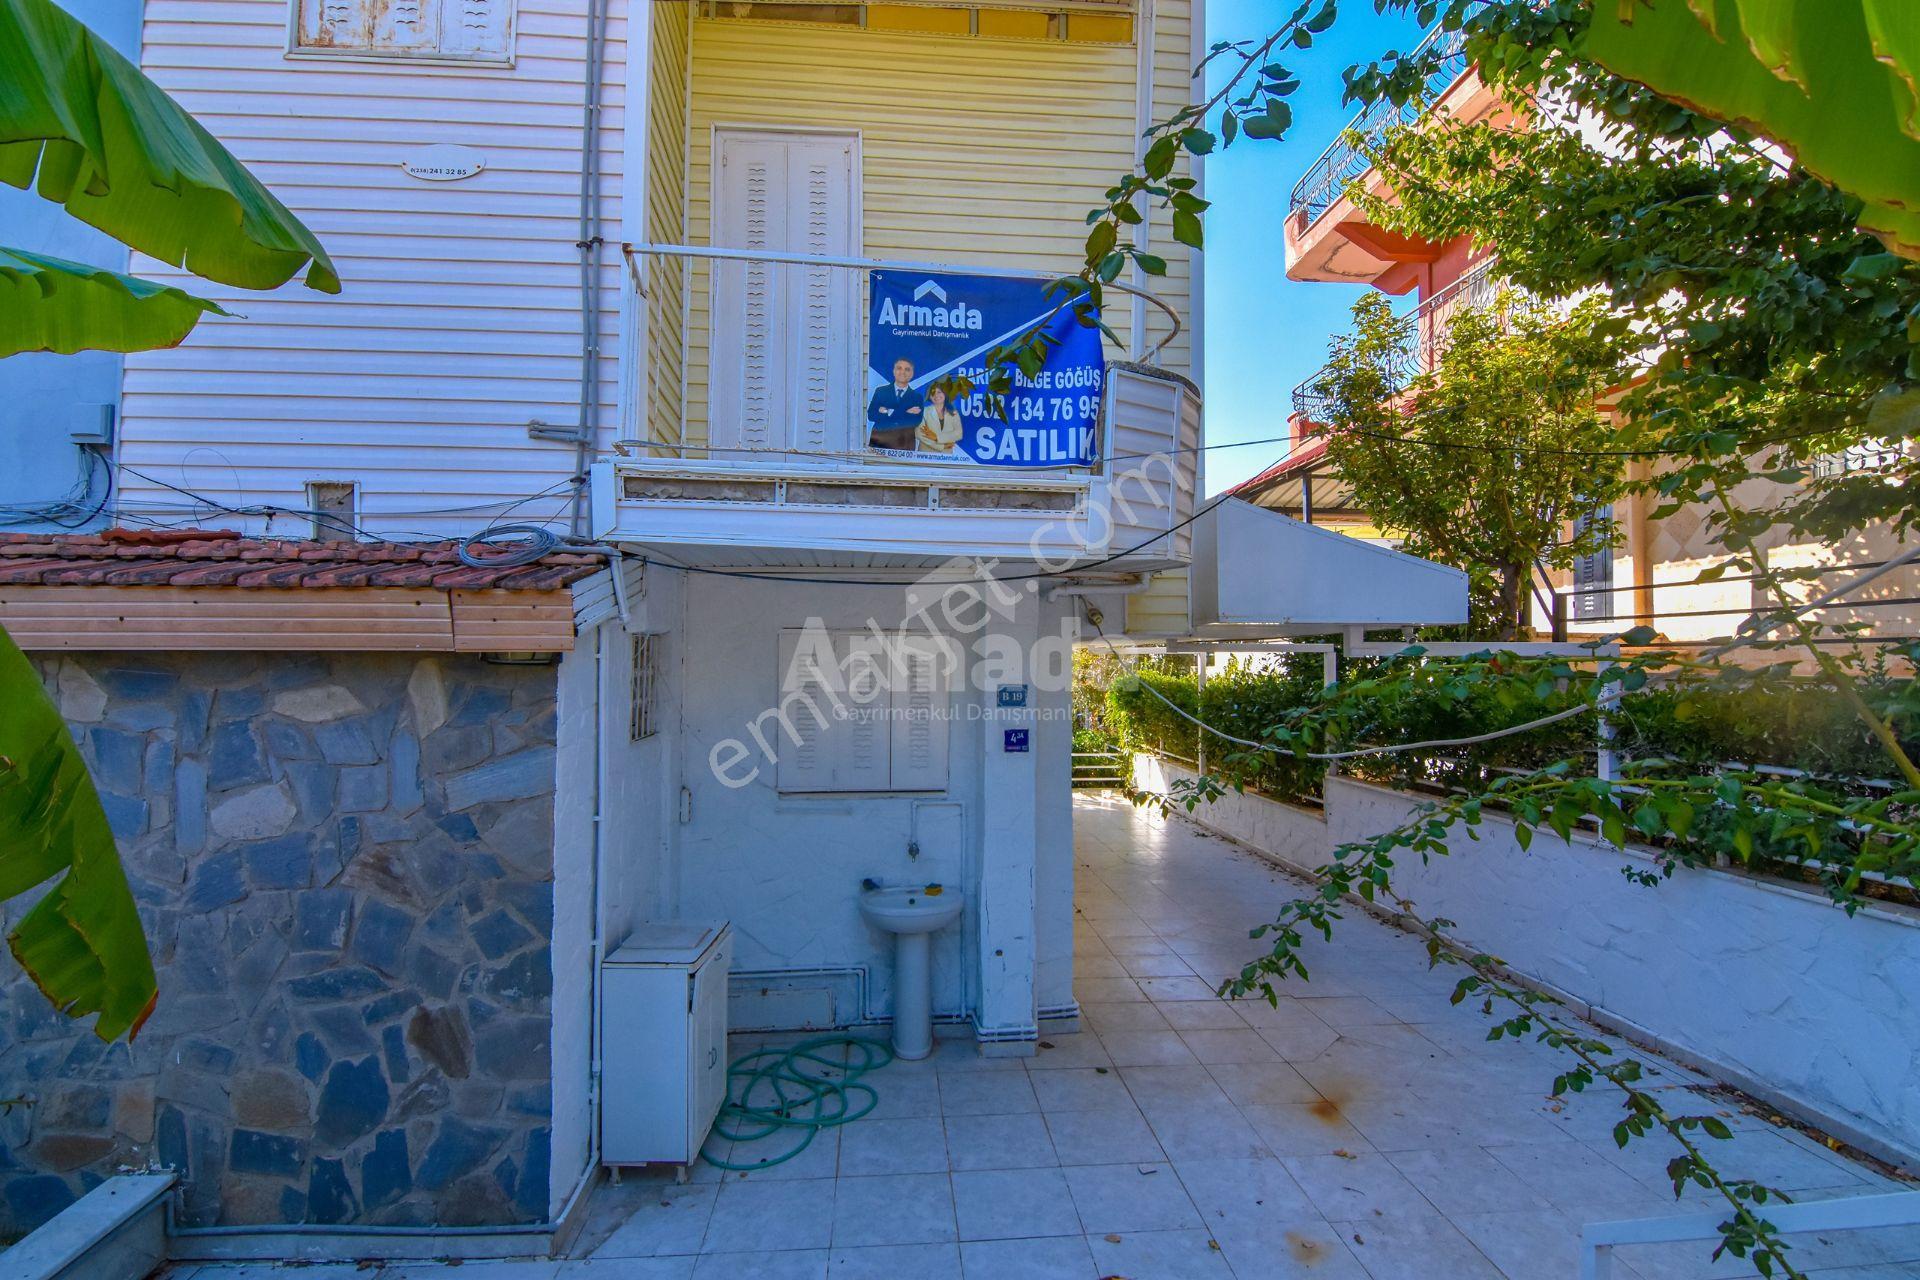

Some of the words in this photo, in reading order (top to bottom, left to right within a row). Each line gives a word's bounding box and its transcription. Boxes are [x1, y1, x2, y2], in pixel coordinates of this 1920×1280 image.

[456, 168, 467, 176] 85
[878, 297, 982, 330] Armada
[892, 328, 932, 338] Gayrimenkul
[1055, 365, 1101, 392] GÖĞÜŞ
[1011, 396, 1045, 421] 134
[1051, 397, 1074, 421] 76
[1079, 395, 1100, 420] 95
[975, 426, 1095, 461] SATILIK
[1013, 692, 1023, 701] 19
[1010, 732, 1017, 744] 4
